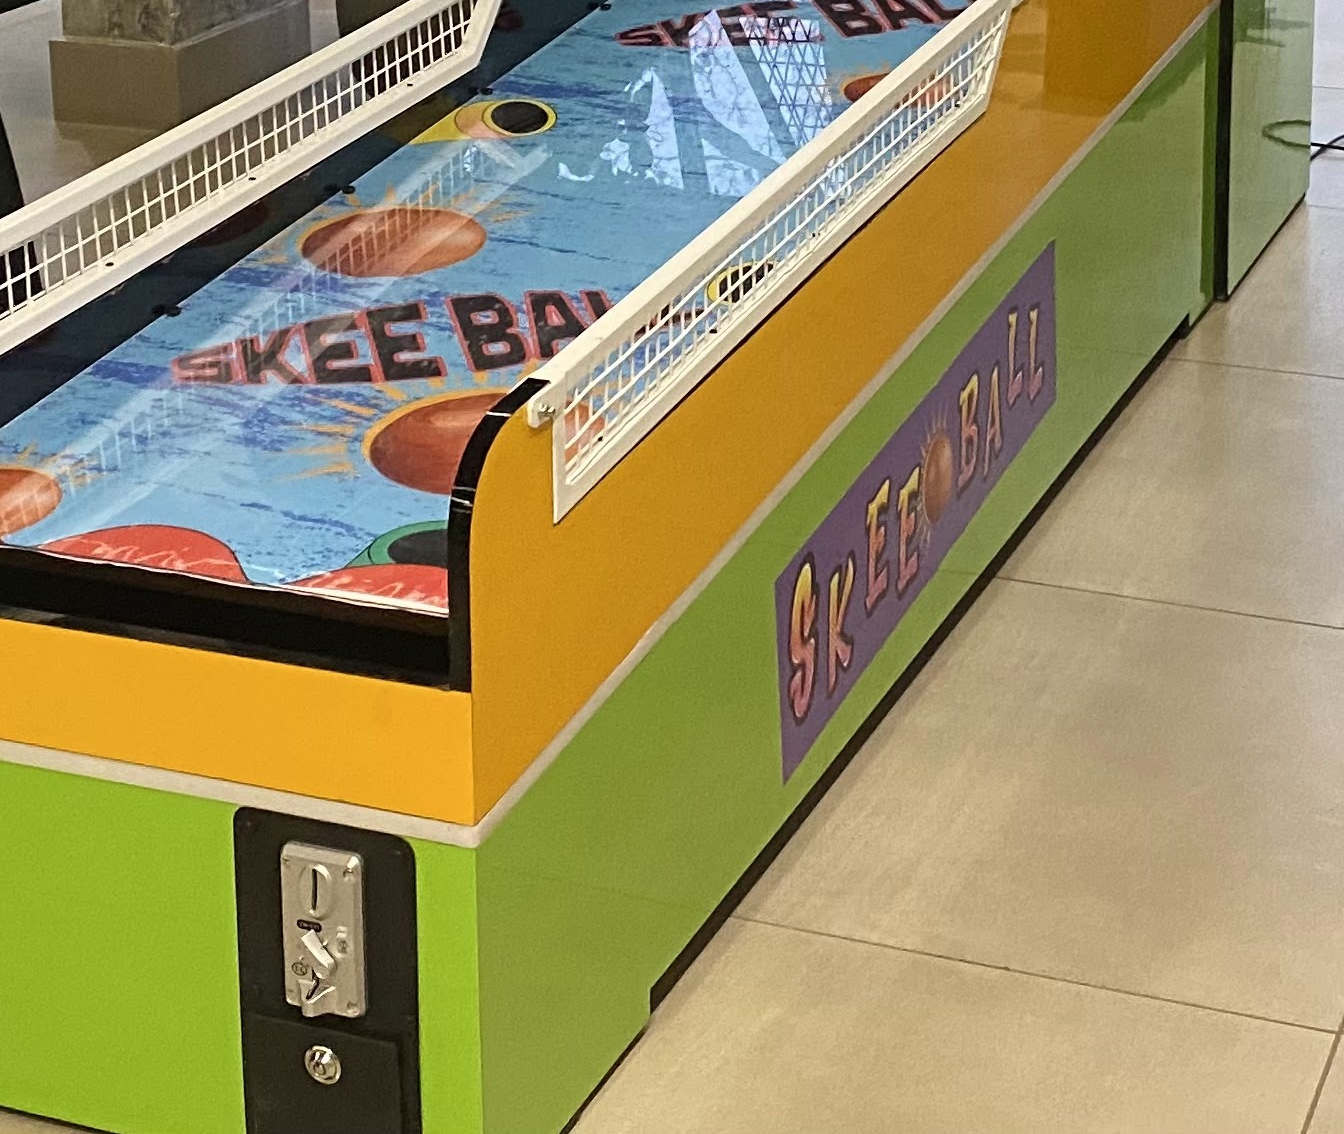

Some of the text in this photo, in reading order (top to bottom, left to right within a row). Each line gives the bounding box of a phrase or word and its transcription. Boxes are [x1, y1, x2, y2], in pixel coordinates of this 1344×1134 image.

[171, 300, 448, 386] SKEE
[787, 303, 1044, 725] SKEE BALL
